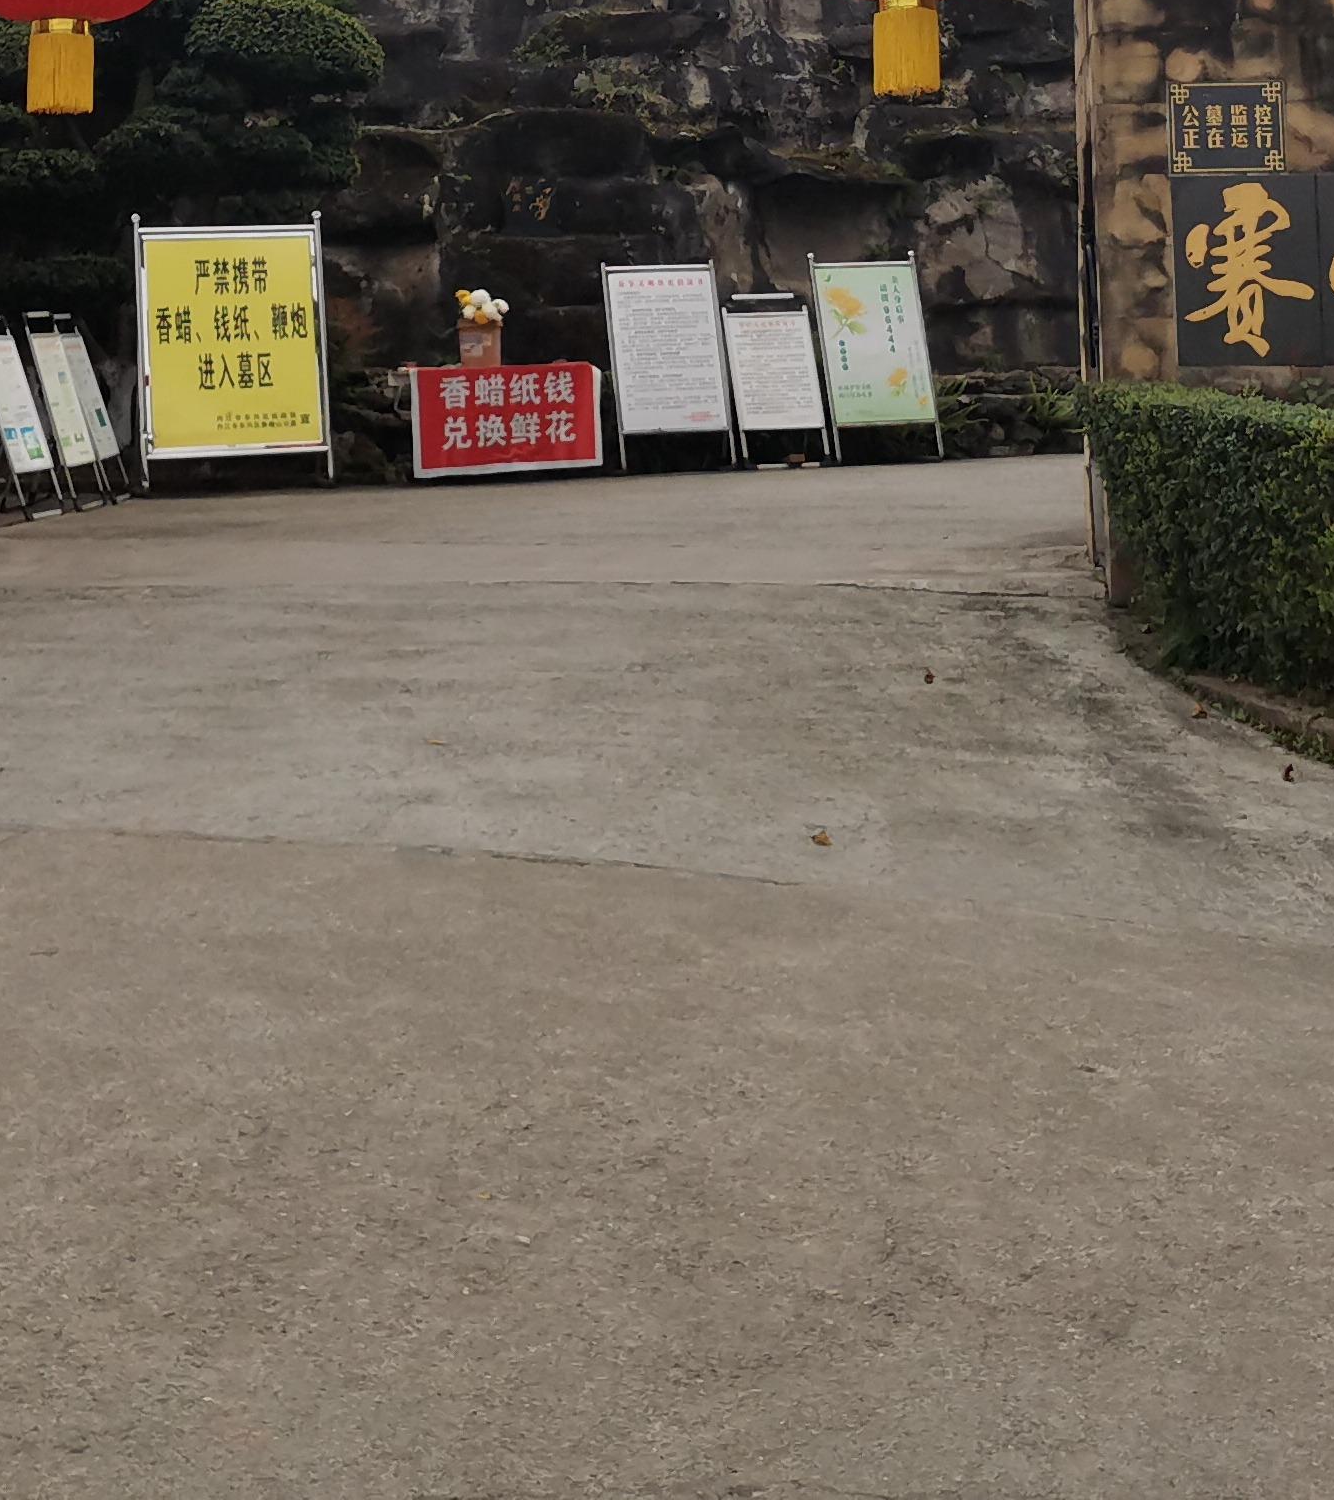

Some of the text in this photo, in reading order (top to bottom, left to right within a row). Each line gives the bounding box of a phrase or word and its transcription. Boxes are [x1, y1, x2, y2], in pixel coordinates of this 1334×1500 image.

[1181, 104, 1274, 127] 公墓监控
[1181, 127, 1275, 149] 正在运行
[194, 256, 268, 295] 严禁携带
[155, 302, 308, 345] 香蜡、钱纸、鞭炮
[198, 351, 274, 391] 进入墓区
[439, 370, 576, 410] 香蜡纸钱
[441, 410, 577, 451] 兑换鲜花
